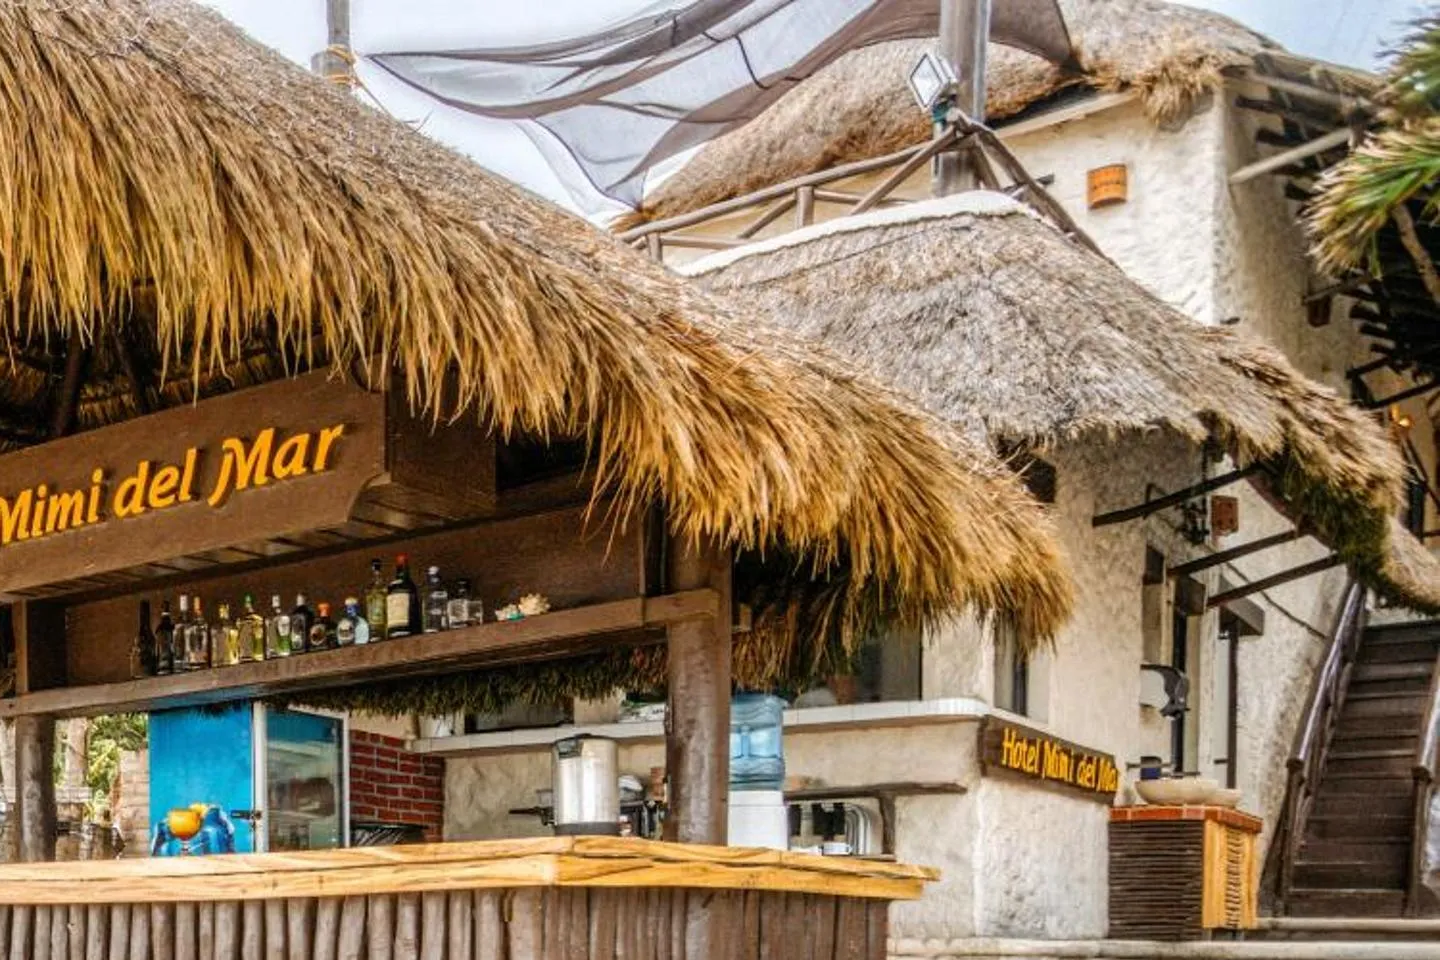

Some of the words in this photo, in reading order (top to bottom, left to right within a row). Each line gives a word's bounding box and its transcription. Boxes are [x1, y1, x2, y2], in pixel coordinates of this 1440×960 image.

[113, 447, 198, 518] del
[207, 423, 345, 507] Mar
[1001, 727, 1042, 774] Hotel
[1042, 738, 1074, 782] Mimi
[1076, 753, 1097, 788] del
